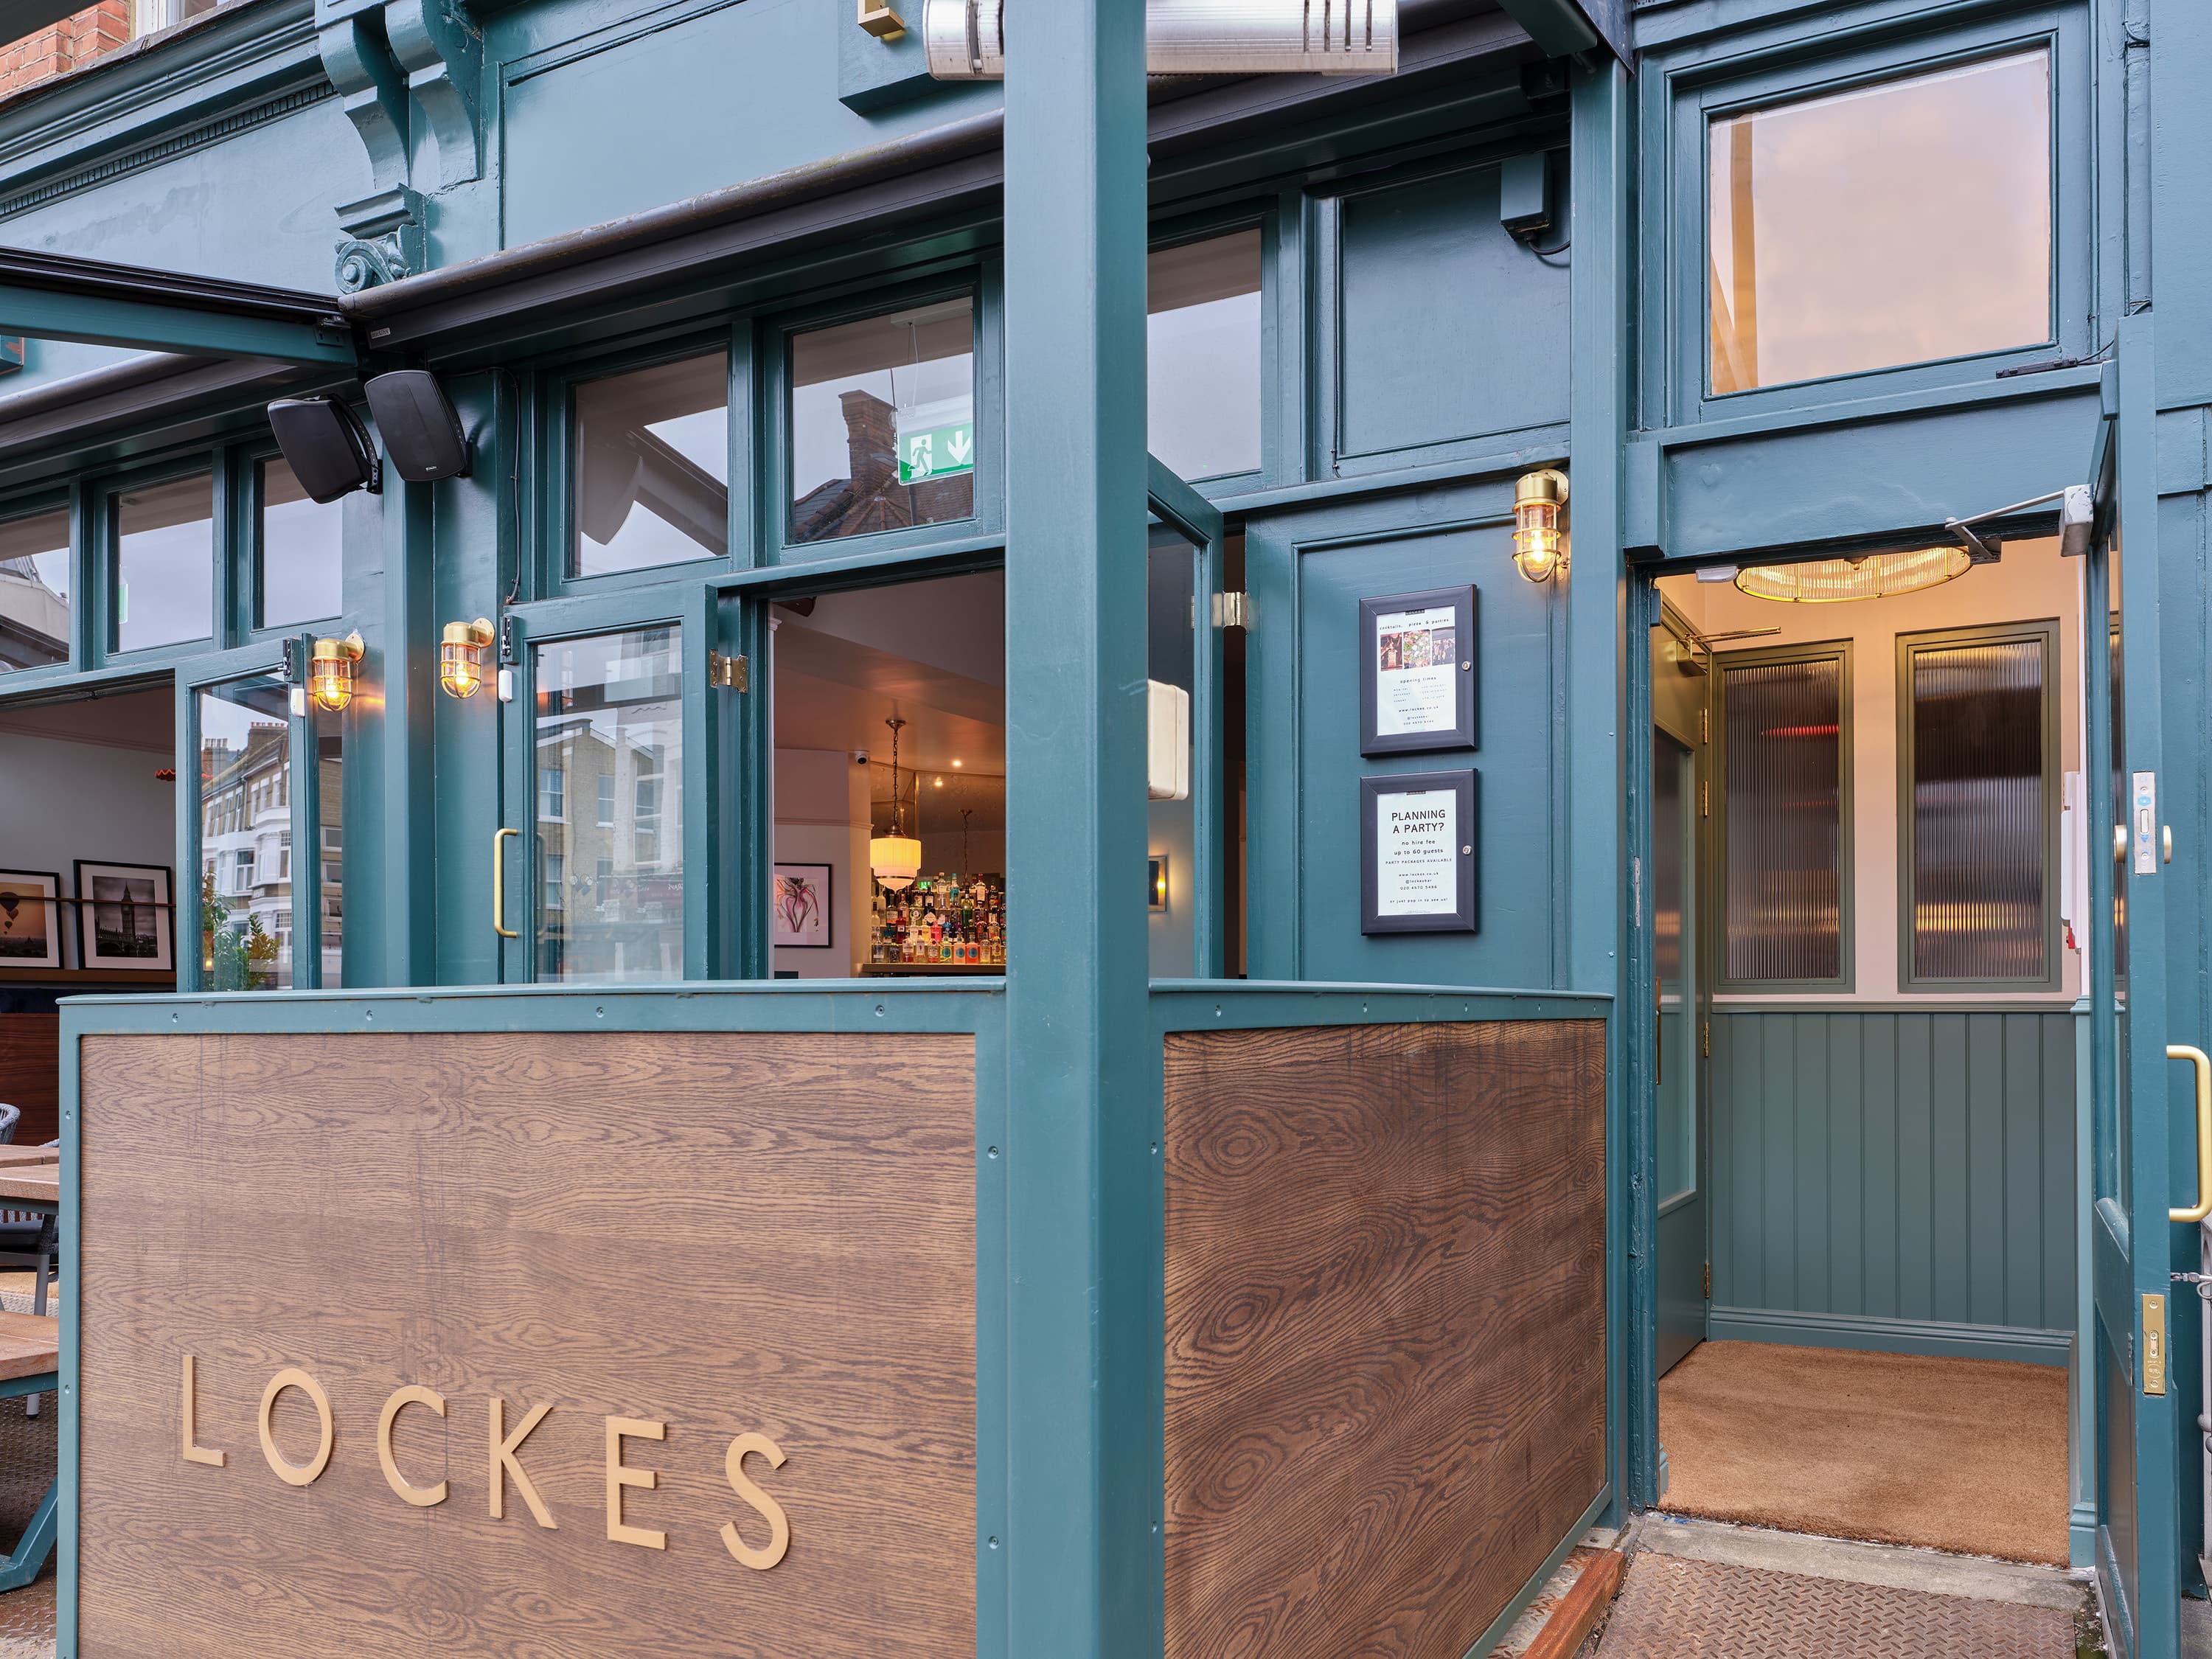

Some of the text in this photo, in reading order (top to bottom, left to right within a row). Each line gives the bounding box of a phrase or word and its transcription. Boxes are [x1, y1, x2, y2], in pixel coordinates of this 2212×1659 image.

[1391, 809, 1446, 821] PLANNING
[1393, 822, 1444, 834] A PARTY?
[182, 1354, 791, 1571] LOCKES
